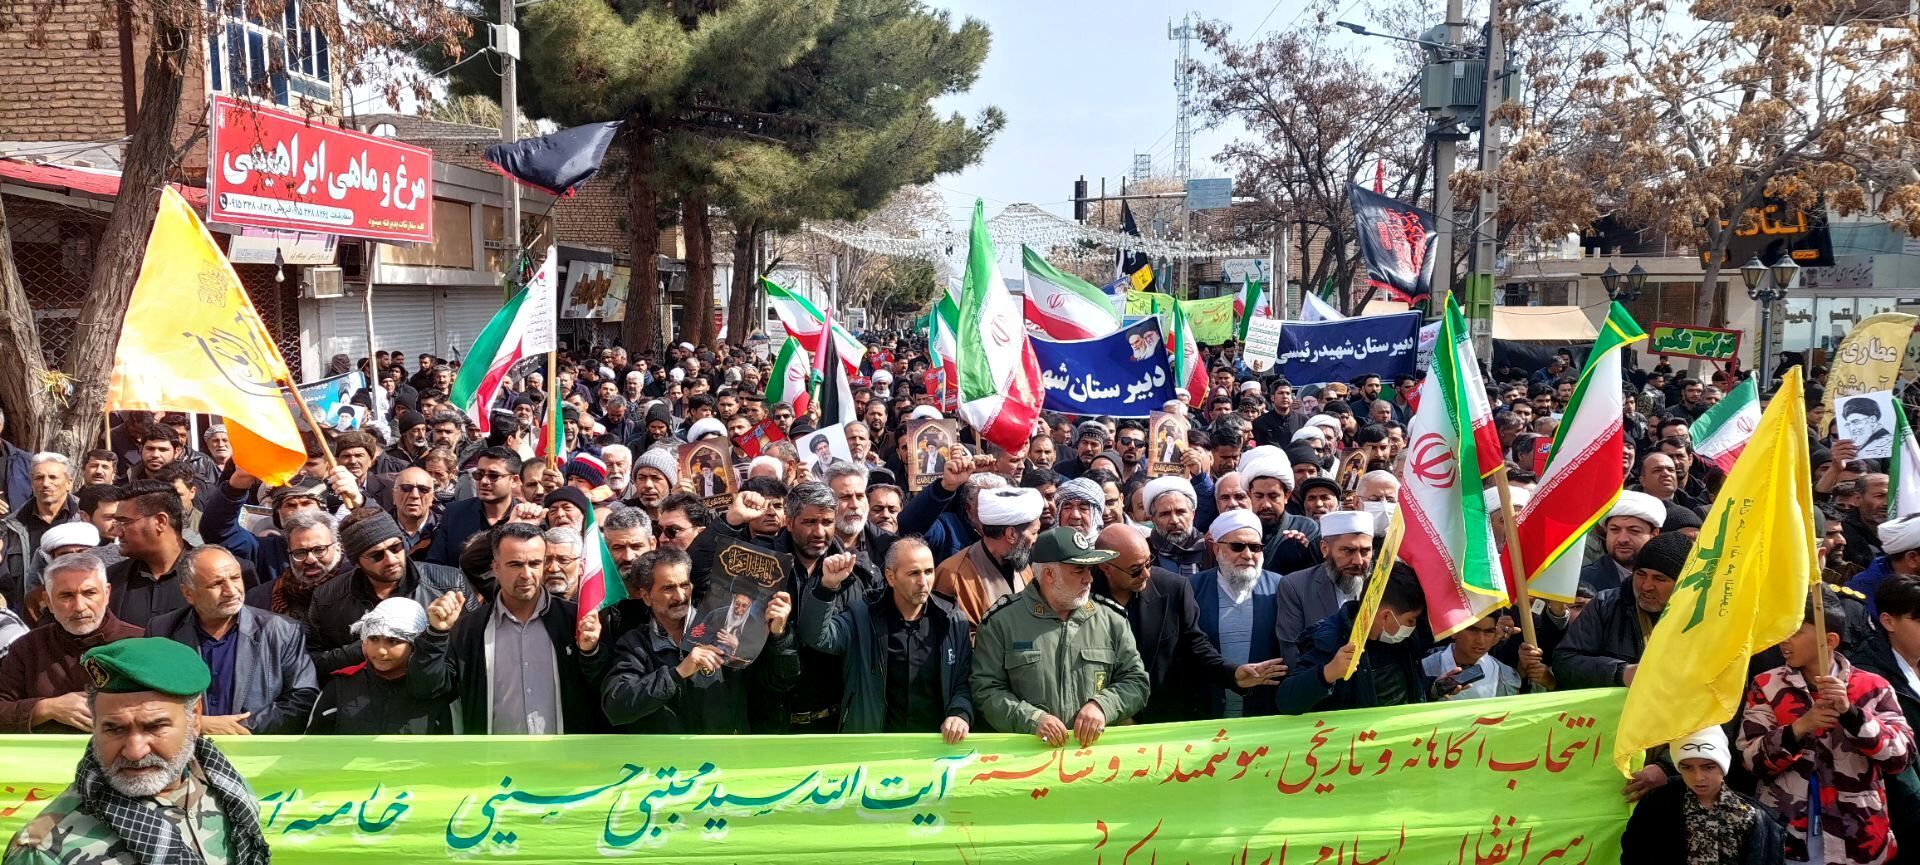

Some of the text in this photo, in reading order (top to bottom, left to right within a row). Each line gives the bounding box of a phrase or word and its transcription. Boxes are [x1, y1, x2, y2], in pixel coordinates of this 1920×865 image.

[223, 133, 426, 211] مرغ و ماهی ابراهیمی
[1319, 339, 1354, 361] شهید
[1354, 336, 1414, 360] دبیرستان
[1652, 328, 1692, 352] عکس
[1841, 336, 1898, 365] عطاری
[1042, 362, 1166, 404] دبیرستان شه
[1102, 755, 1120, 784] و
[1129, 728, 1270, 786] هوشمندانه
[1277, 720, 1377, 795] تاریخی
[1372, 748, 1393, 777] و
[1400, 710, 1511, 772] آگاهانه
[1488, 711, 1602, 791] انتخاب
[445, 763, 645, 850] حسینی
[603, 761, 715, 847] مجتبی
[692, 769, 821, 830] سید
[797, 765, 862, 805] الله
[861, 748, 976, 826] آیت
